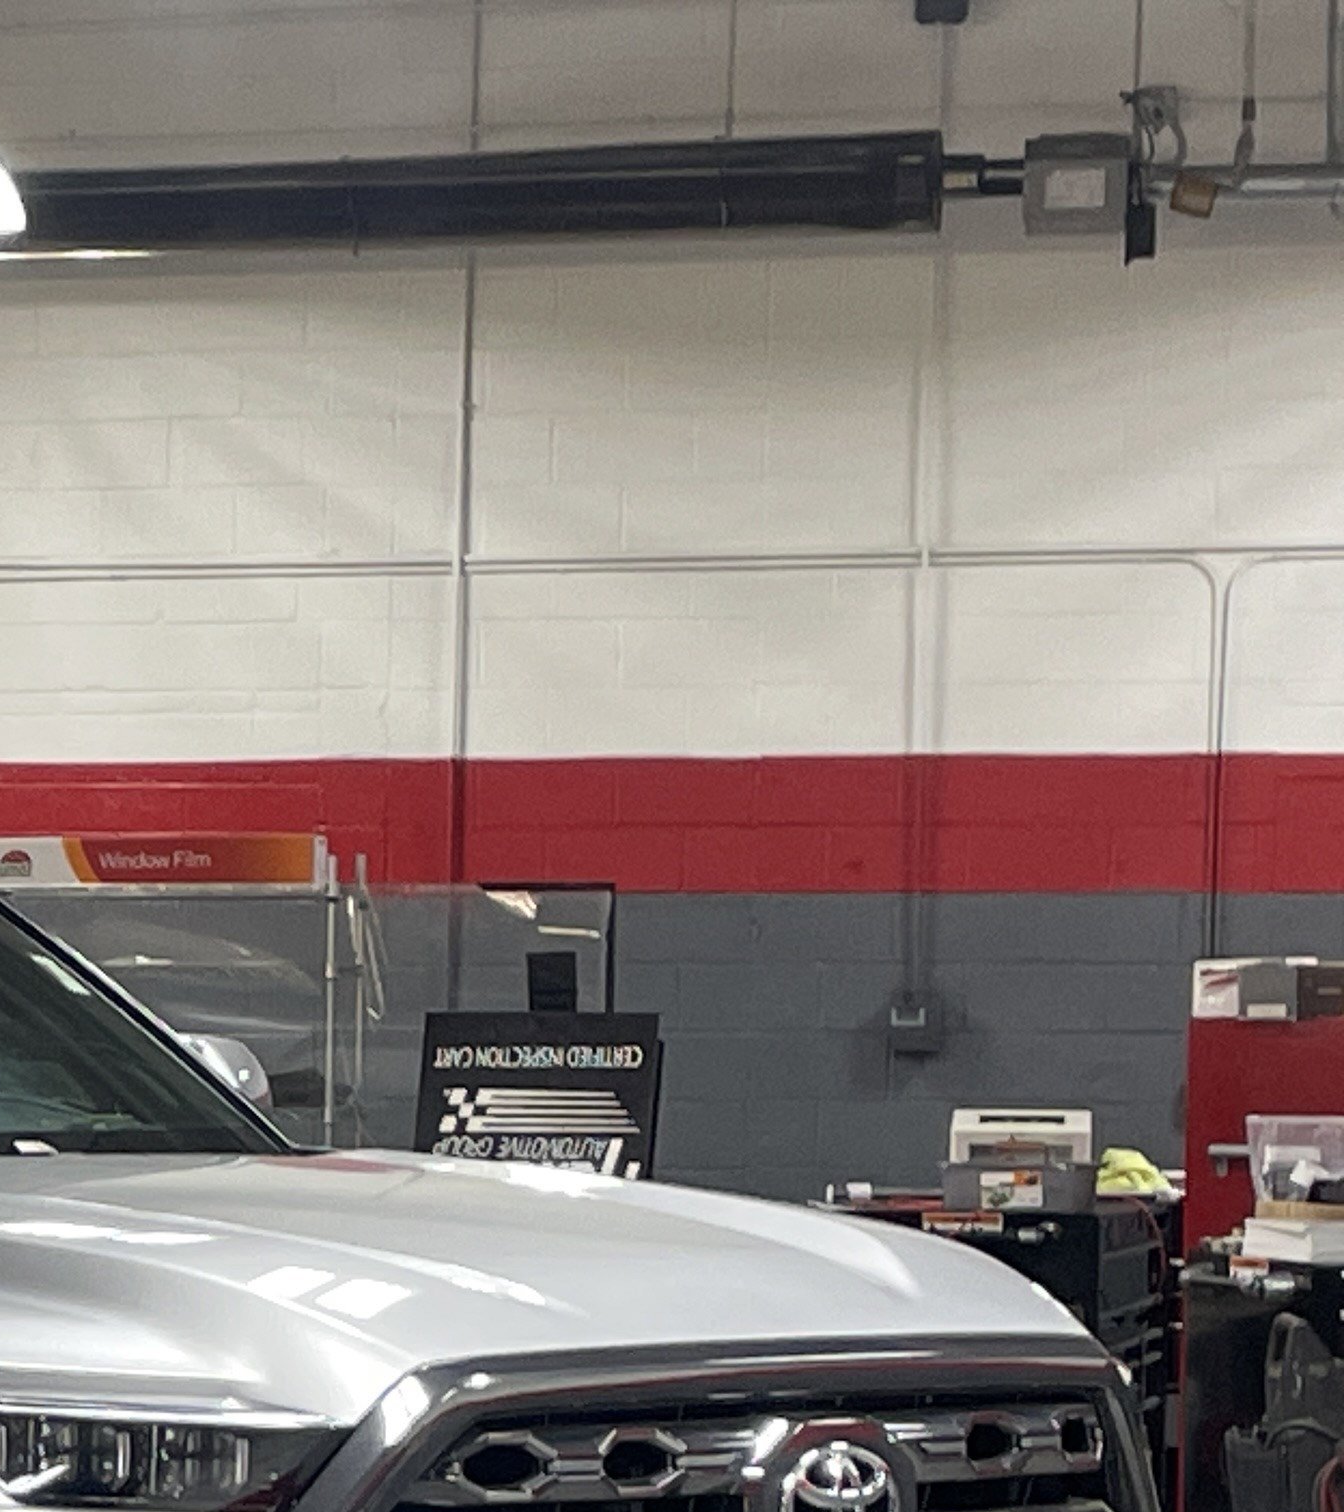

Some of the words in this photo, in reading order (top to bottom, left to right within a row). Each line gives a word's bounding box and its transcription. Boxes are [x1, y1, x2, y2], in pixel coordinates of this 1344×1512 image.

[99, 851, 171, 869] Window
[173, 850, 213, 868] Film
[433, 1045, 474, 1068] CART
[475, 1044, 565, 1069] INSPECTION
[566, 1044, 643, 1070] CERTIFIED
[432, 1135, 494, 1158] GROUP
[495, 1136, 609, 1161] AUTOMOTIVE
